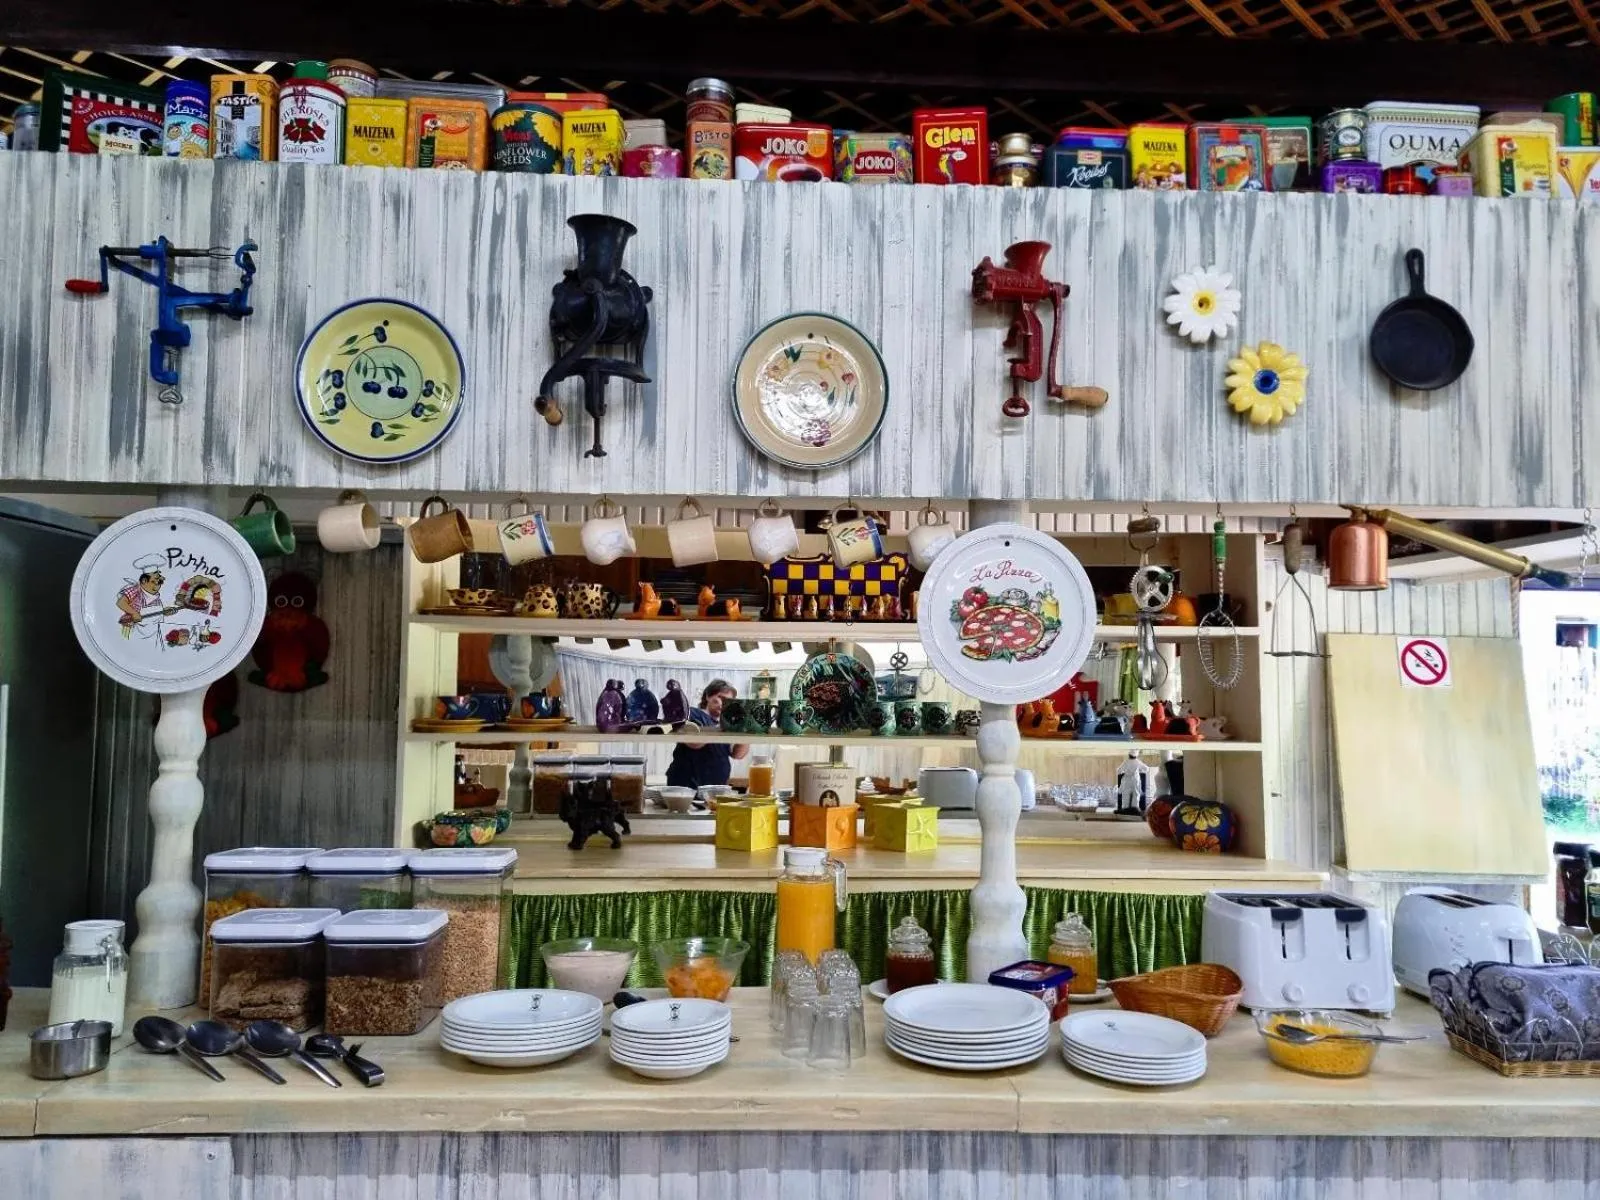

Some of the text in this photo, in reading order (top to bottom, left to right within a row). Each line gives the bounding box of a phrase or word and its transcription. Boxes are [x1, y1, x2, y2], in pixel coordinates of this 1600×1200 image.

[220, 96, 259, 106] TASTIC
[83, 109, 126, 124] CHOICE
[168, 103, 209, 120] Marie
[298, 105, 330, 127] ROSES
[353, 125, 395, 139] MAIZENA
[571, 122, 607, 134] MAIZENA
[694, 130, 730, 143] BISTO
[925, 126, 976, 148] Glen
[1388, 134, 1461, 152] OUMA
[282, 144, 325, 156] Quality Tea
[494, 146, 547, 160] SUNFLOWER
[761, 137, 809, 155] JOKO
[1143, 141, 1178, 152] MAIZENA
[502, 155, 532, 166] SEEDS
[855, 156, 894, 170] JOKO
[1067, 161, 1113, 188] Rooibos
[969, 559, 1043, 583] La Pizza
